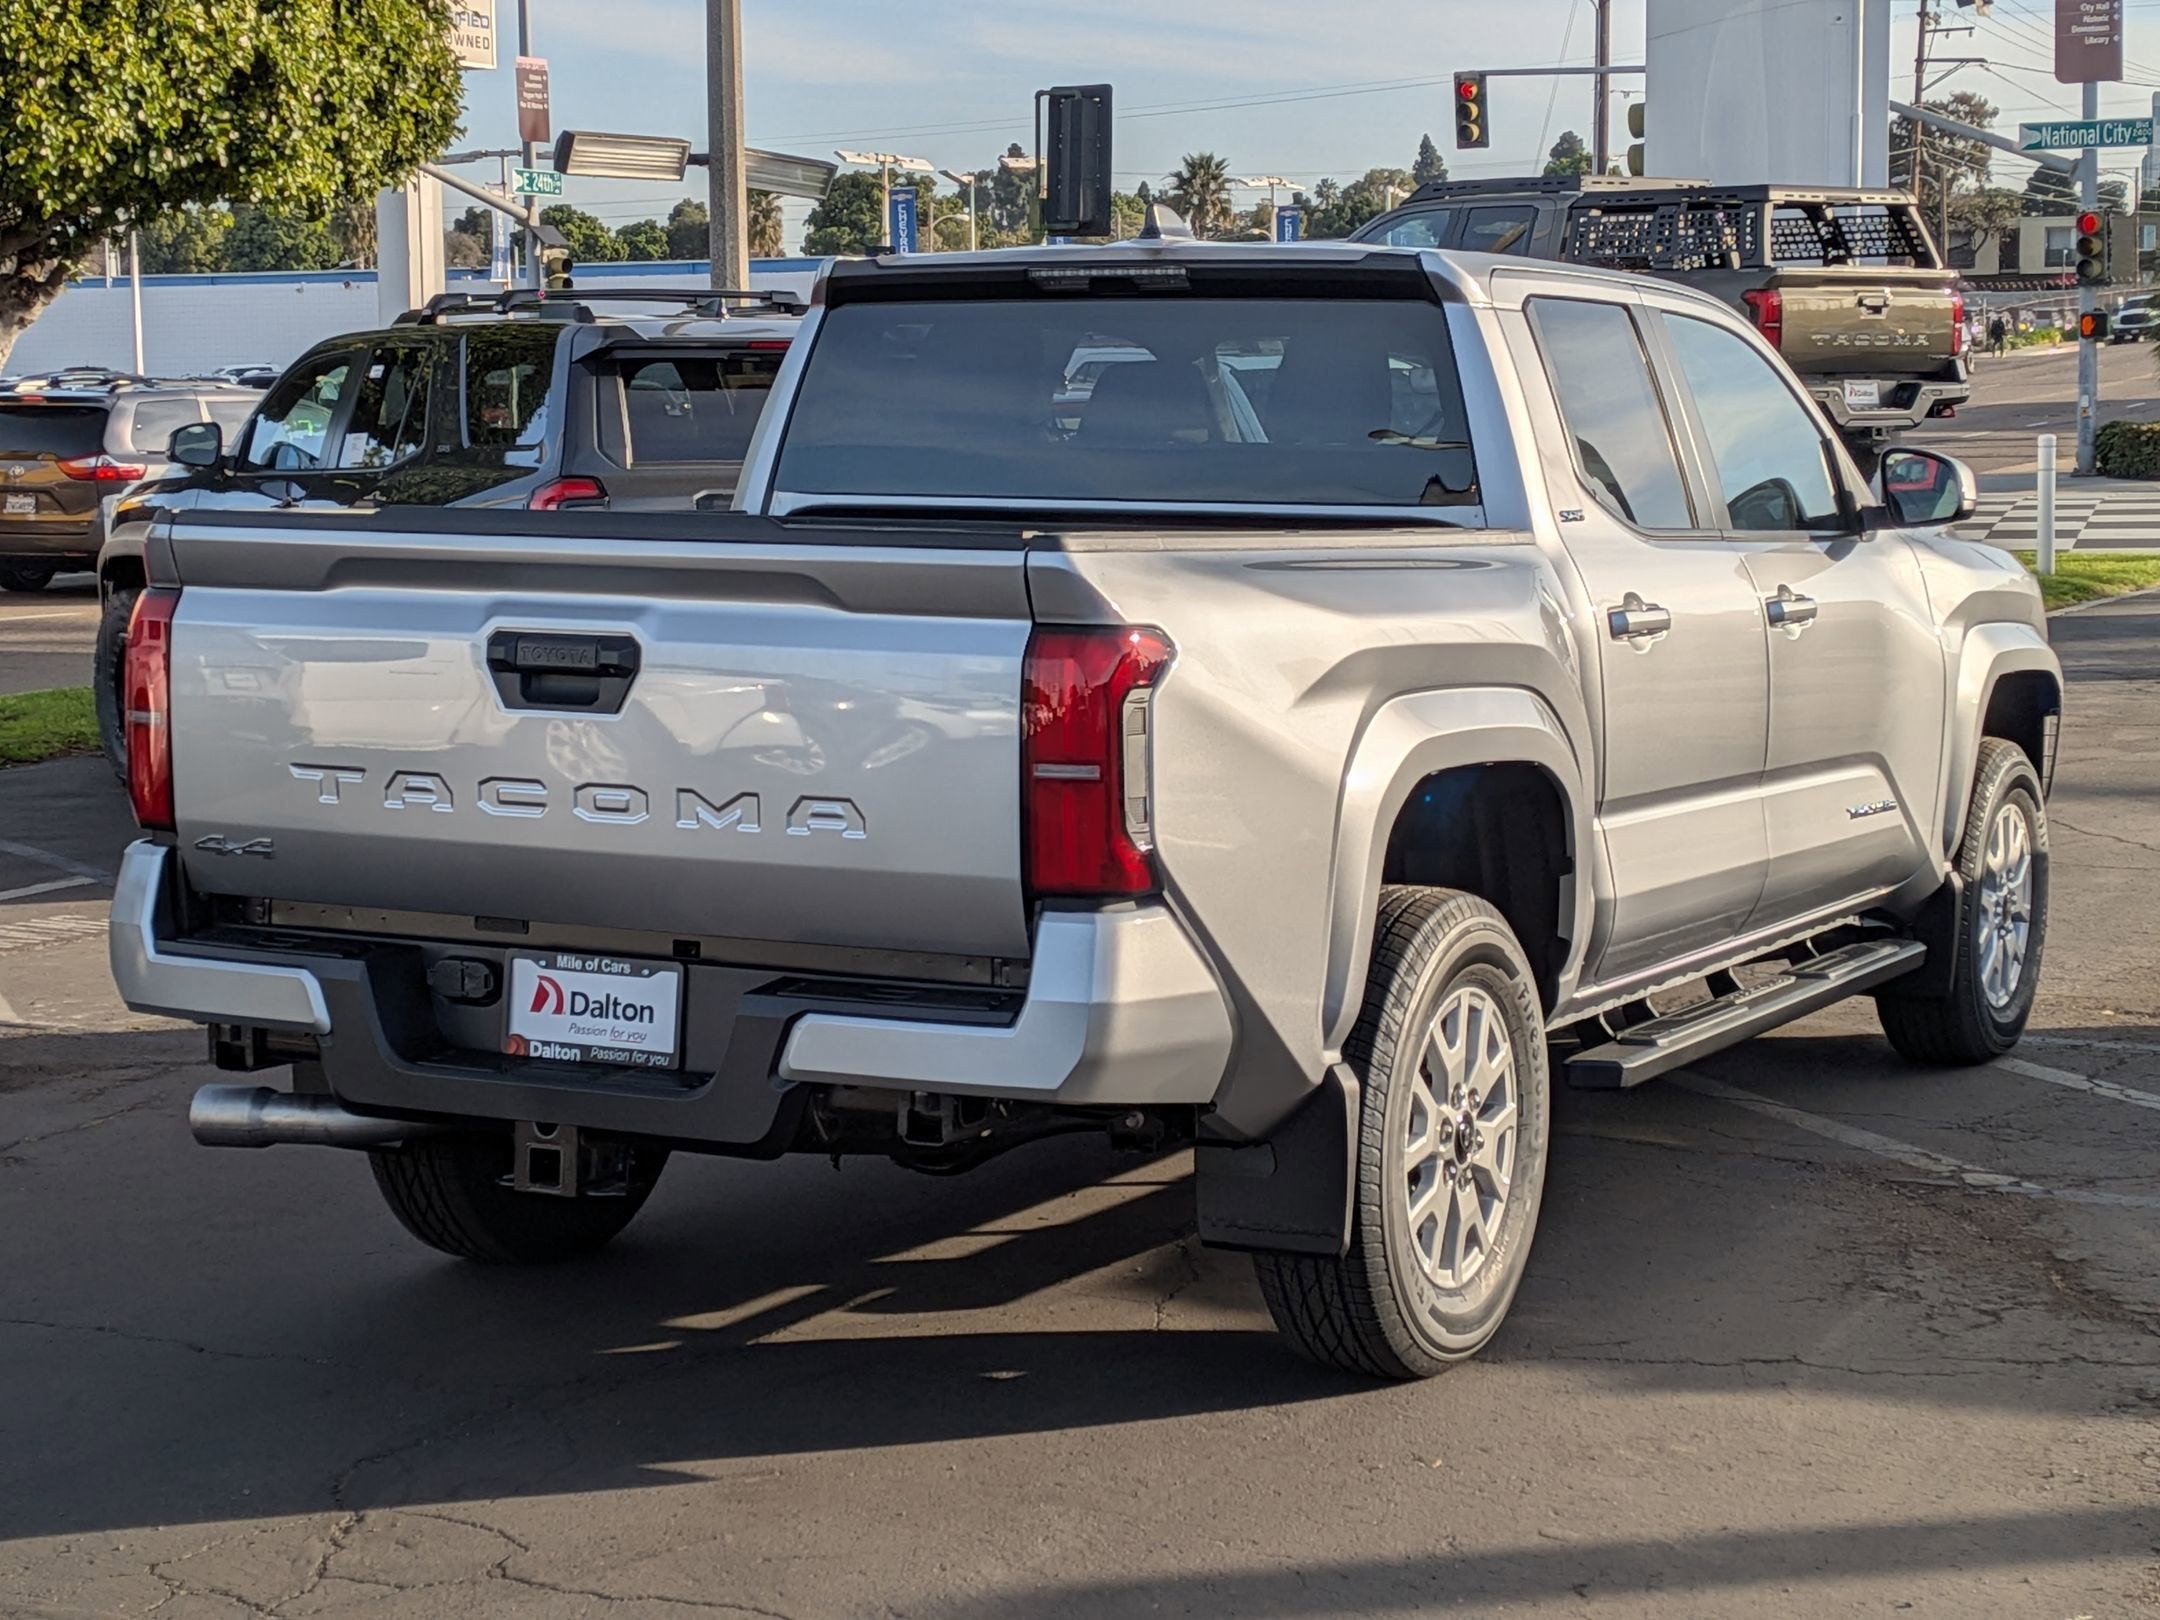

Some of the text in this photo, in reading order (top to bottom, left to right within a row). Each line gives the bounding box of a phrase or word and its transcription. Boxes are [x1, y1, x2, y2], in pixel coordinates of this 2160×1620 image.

[2041, 123, 2133, 146] National City
[2133, 128, 2152, 136] 2400
[523, 172, 553, 192] E 24th
[897, 203, 909, 254] CHEVRO
[1811, 334, 1929, 346] TACOMA
[520, 645, 594, 665] TOYOTA
[289, 762, 867, 839] TACOMA
[556, 955, 631, 974] Mile of Cars
[569, 991, 654, 1024] Dalton
[568, 1022, 648, 1041] Passion for you
[529, 1041, 670, 1067] Dalton Passion for you
